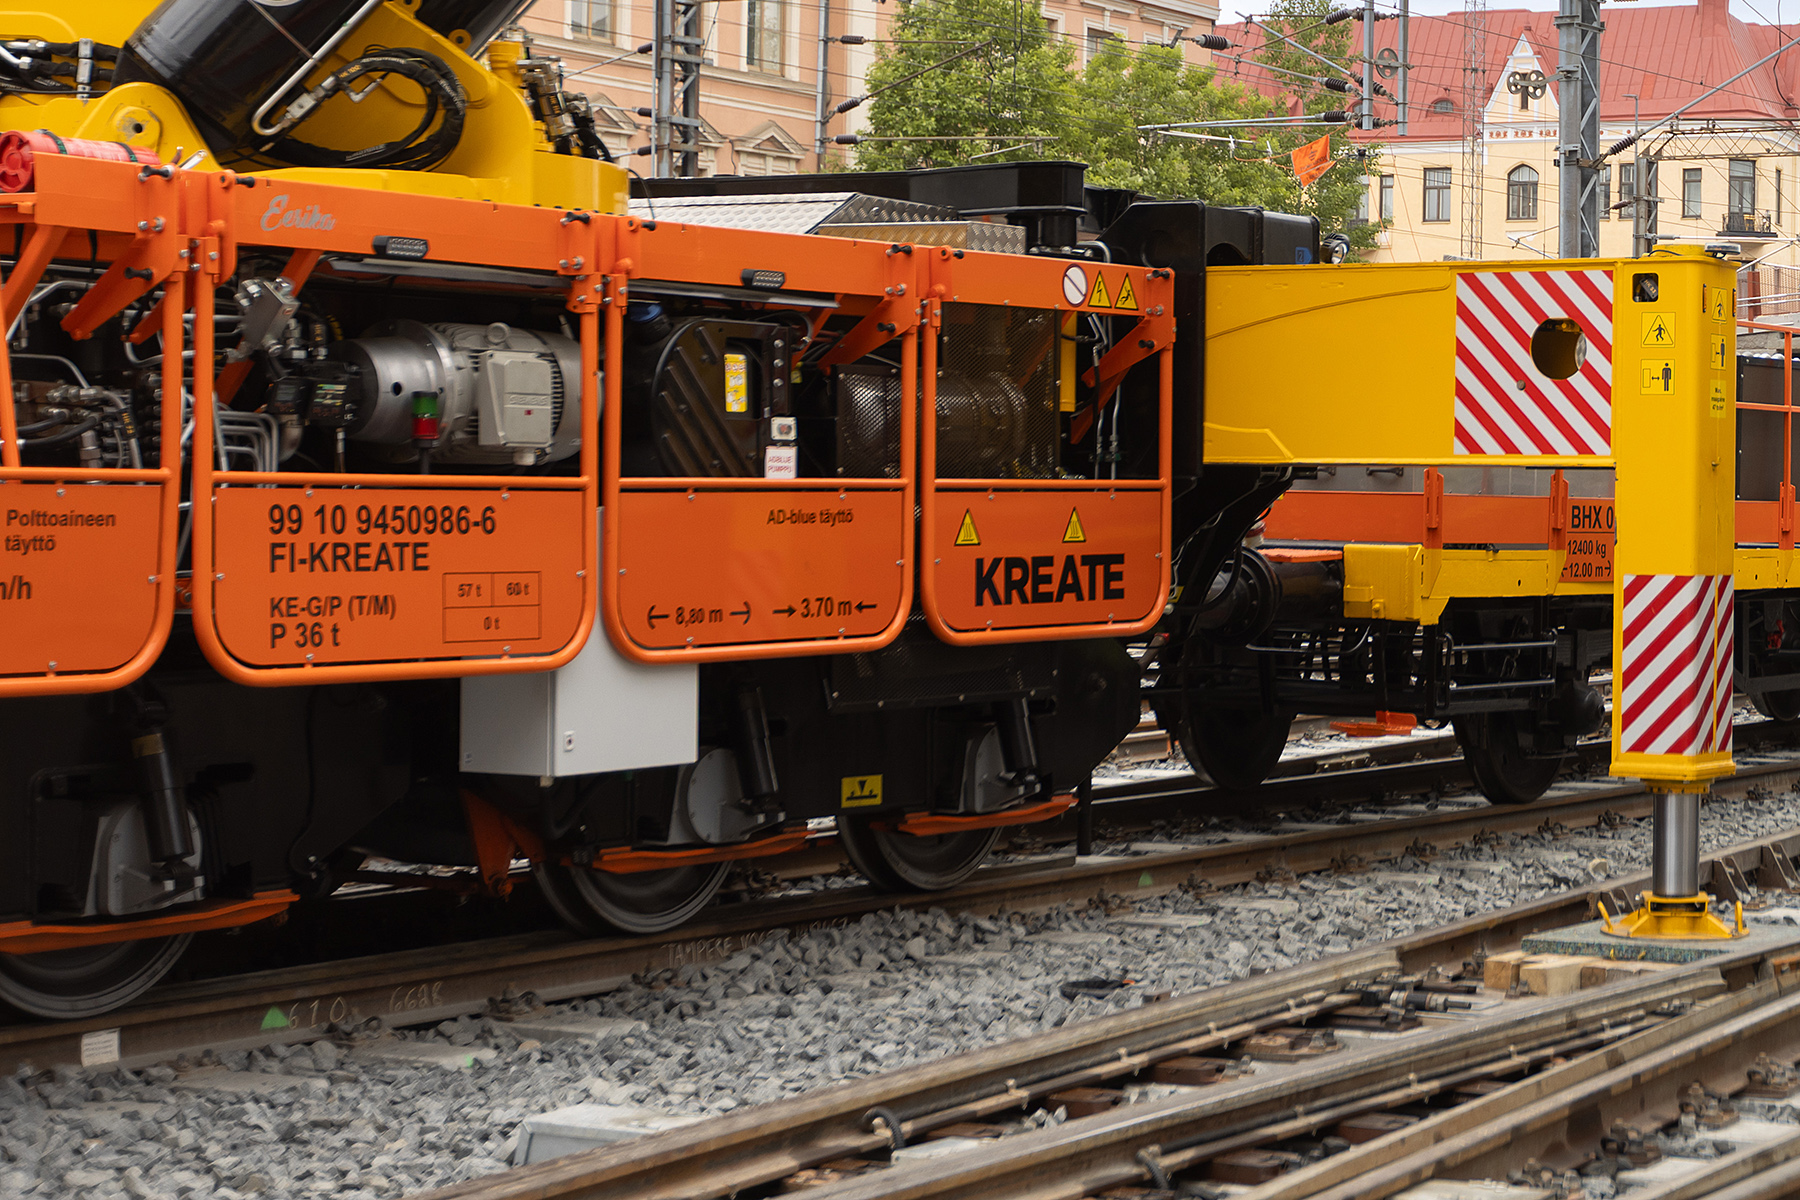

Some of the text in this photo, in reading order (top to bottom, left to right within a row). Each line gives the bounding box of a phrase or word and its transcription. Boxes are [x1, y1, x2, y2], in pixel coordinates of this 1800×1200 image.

[260, 194, 336, 231] Eerika
[6, 509, 116, 527] Polttoaineen
[268, 504, 497, 535] 99 10 9450986-6
[766, 508, 854, 527] AD-blue täyttö
[1571, 505, 1602, 529] BHX
[5, 535, 56, 555] täyttö
[1568, 540, 1606, 558] 12400 kg
[269, 542, 430, 573] FI-KREATE
[975, 553, 1124, 607] KREATE
[1569, 562, 1603, 577] 12.00 m
[458, 583, 482, 597] 57 t
[524, 583, 529, 596] t
[269, 594, 397, 621] KE-G/P (T/M)
[675, 596, 852, 628] 8,80 m 3.70 m
[494, 617, 500, 630] t
[270, 622, 341, 649] P 36 t
